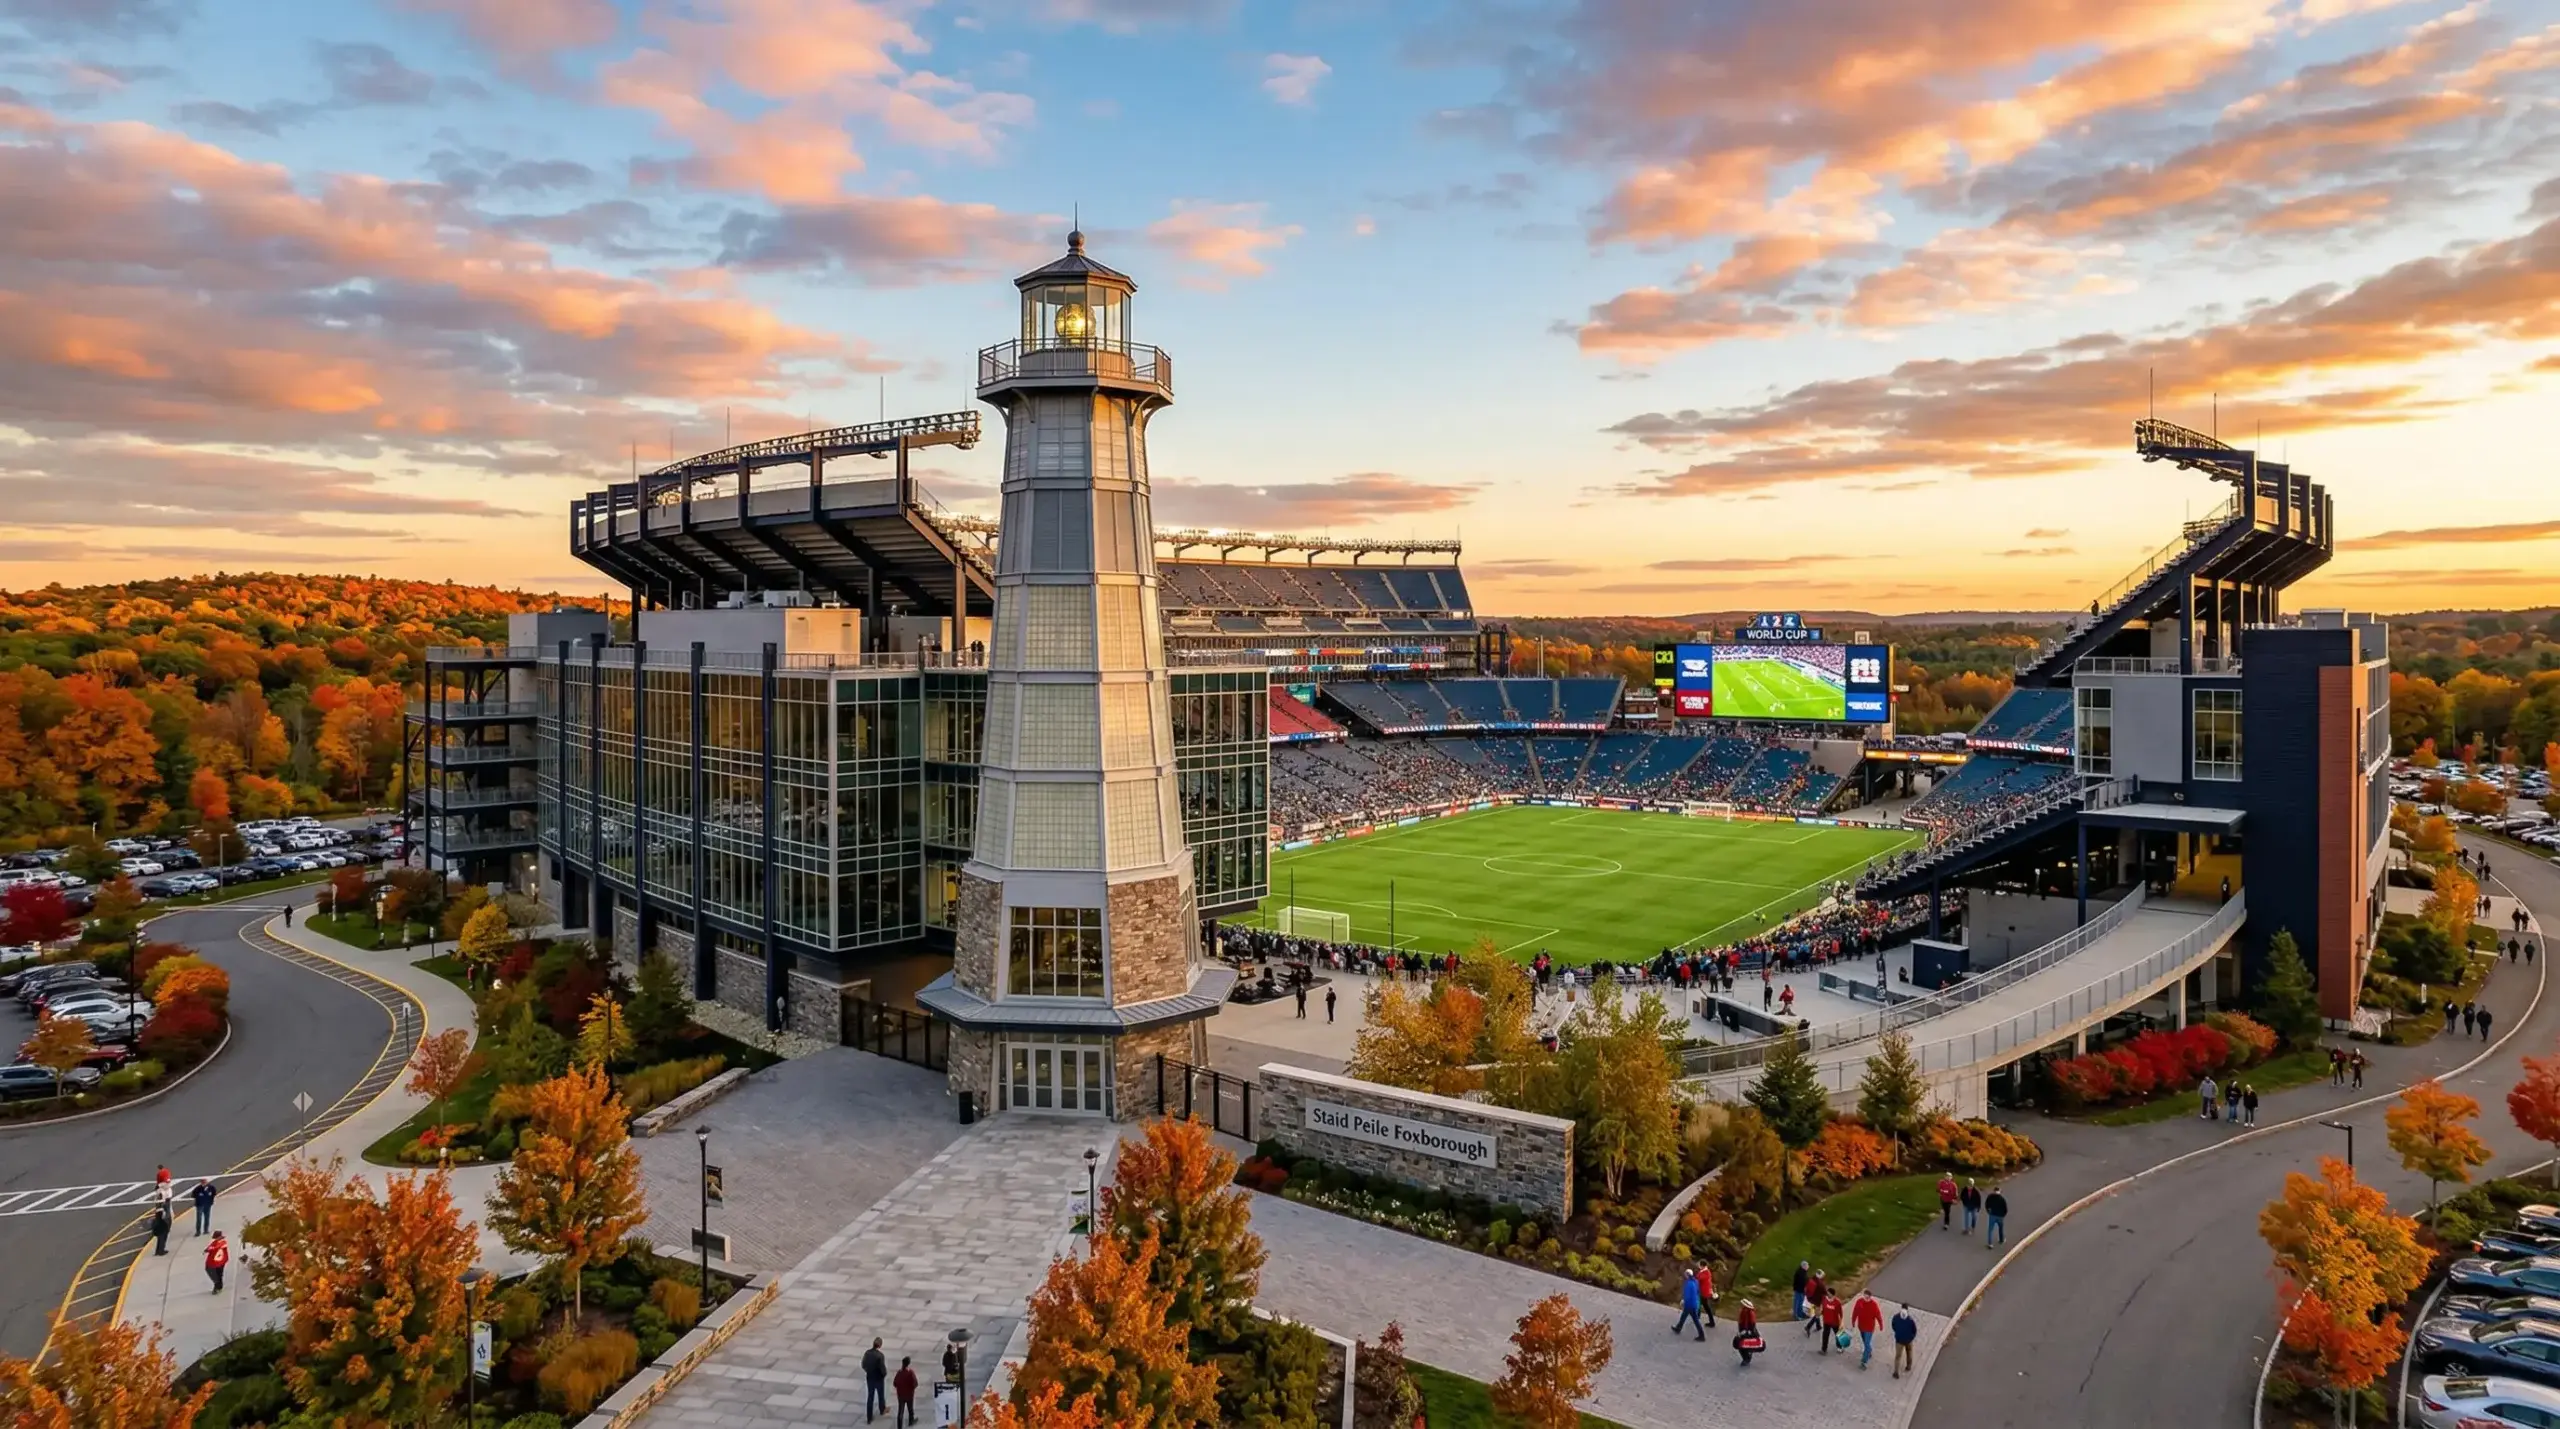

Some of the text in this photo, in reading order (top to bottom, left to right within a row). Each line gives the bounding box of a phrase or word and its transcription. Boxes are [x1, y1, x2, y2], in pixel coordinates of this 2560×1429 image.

[1746, 629, 1808, 640] WORLD CUP
[1313, 1108, 1488, 1161] Staid Peile Foxborough
